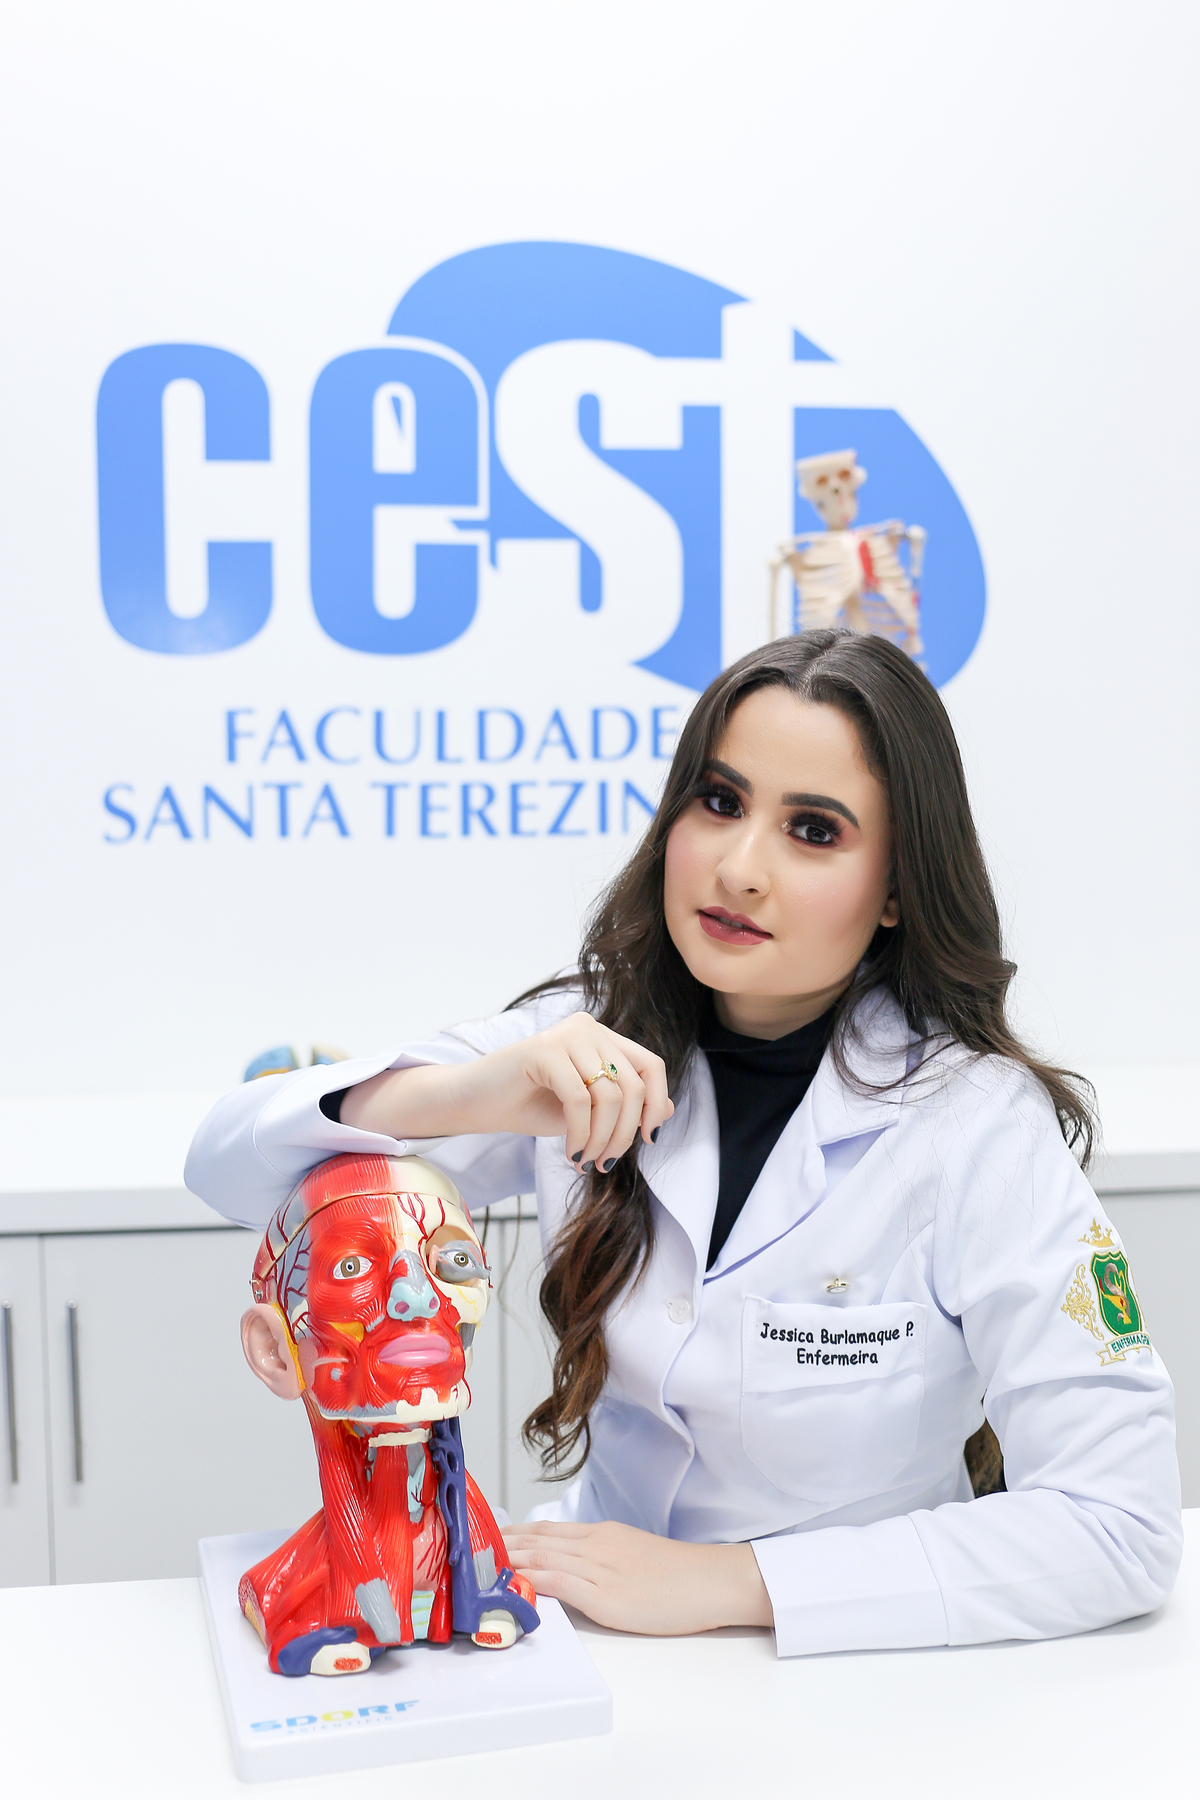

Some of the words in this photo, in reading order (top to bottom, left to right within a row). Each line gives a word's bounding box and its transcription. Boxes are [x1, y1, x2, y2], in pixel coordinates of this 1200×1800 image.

[225, 705, 679, 765] FACULDADE
[102, 782, 351, 844] SANTA
[760, 1322, 814, 1344] Jessica
[820, 1328, 900, 1346] Burlamaque
[905, 1321, 914, 1337] P.
[796, 1348, 878, 1366] Enfermeira
[250, 1699, 420, 1733] SDORF
